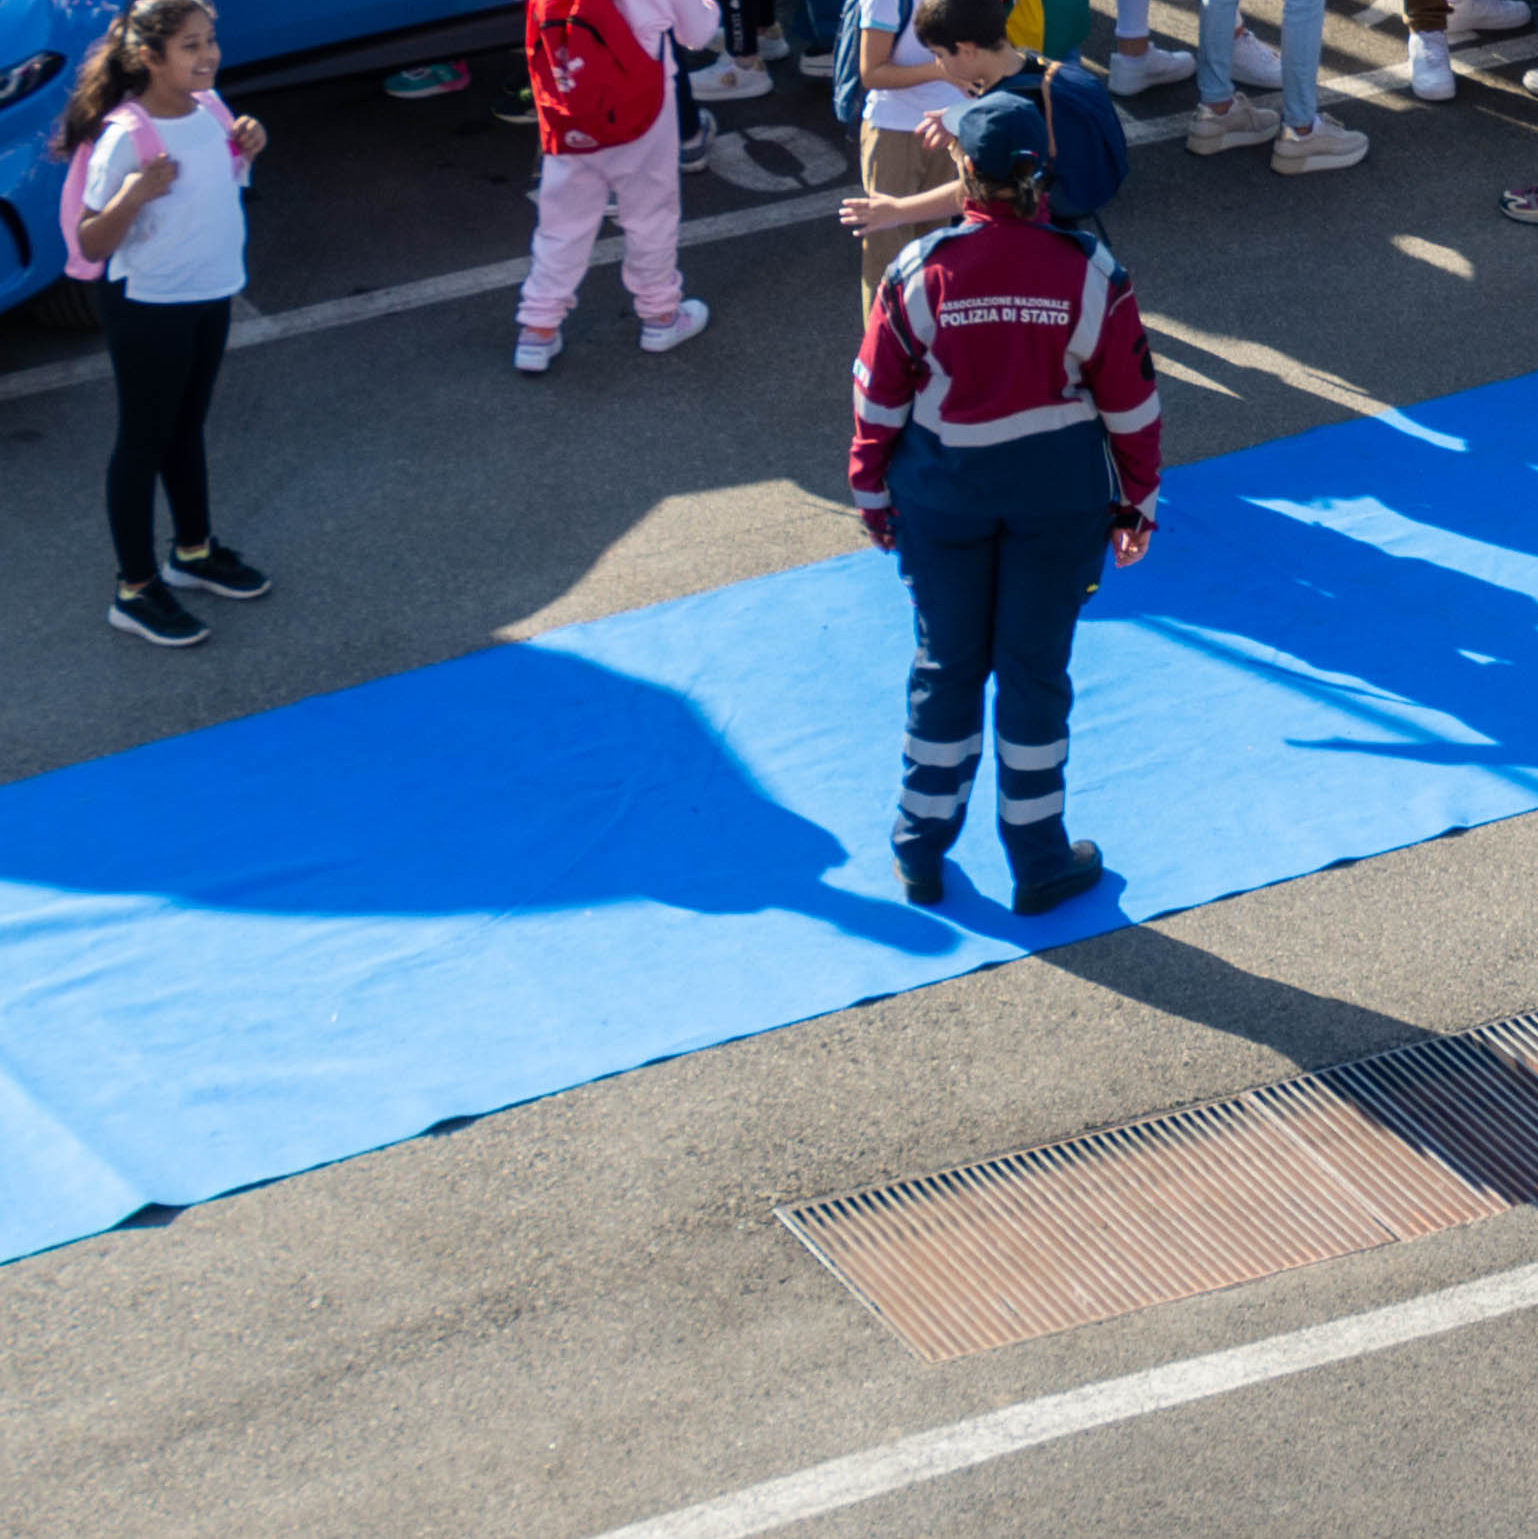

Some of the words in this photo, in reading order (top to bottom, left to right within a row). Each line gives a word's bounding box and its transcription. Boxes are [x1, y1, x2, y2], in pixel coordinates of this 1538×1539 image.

[942, 296, 1013, 311] ASSOCIAZIONE
[1013, 297, 1070, 310] NAZIONALE
[940, 308, 999, 328] POLIZIA
[1002, 308, 1016, 322] DI
[1020, 308, 1069, 325] STATO
